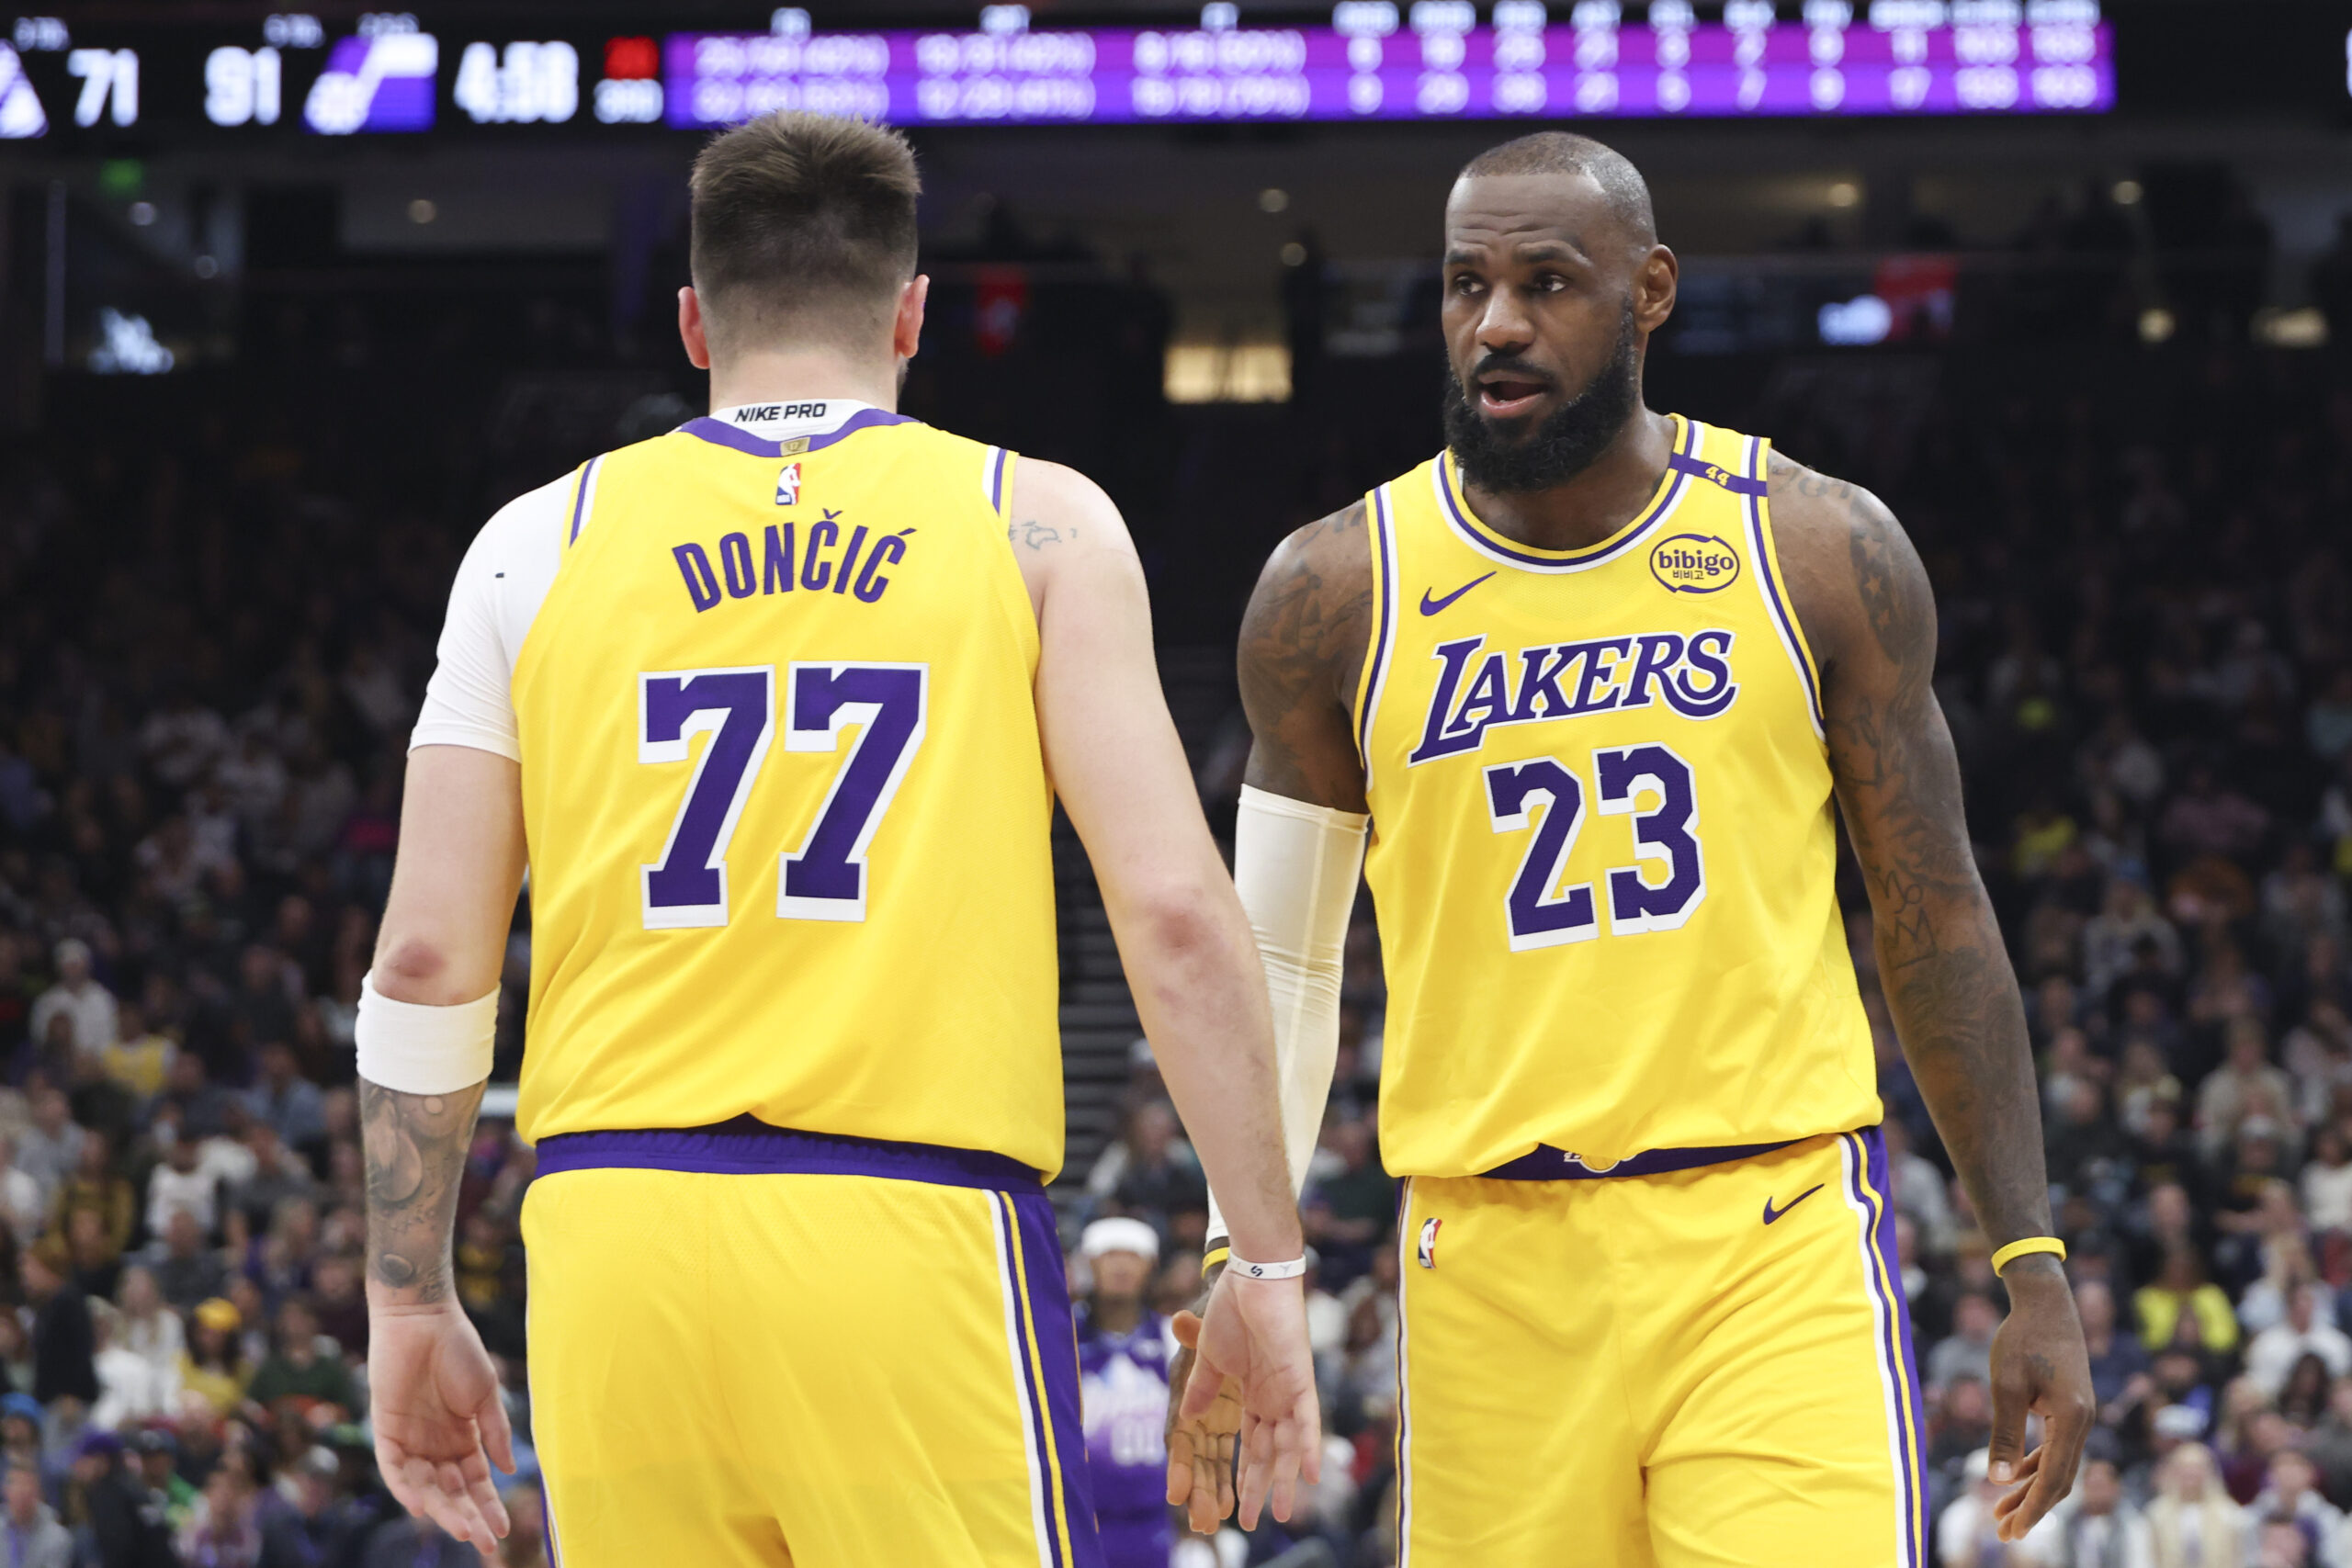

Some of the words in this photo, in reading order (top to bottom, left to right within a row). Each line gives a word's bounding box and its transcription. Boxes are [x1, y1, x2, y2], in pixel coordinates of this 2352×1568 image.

[67, 49, 139, 127] 71
[735, 406, 781, 423] NIKE
[784, 402, 827, 420] PRO
[1705, 466, 1731, 487] 44
[672, 508, 917, 614] DONČIĆ
[1658, 549, 1735, 576] bibigo
[1673, 570, 1704, 581] 비비고
[1407, 631, 1741, 768] LAKERS
[638, 660, 930, 931] 77
[1482, 740, 1707, 953] 23
